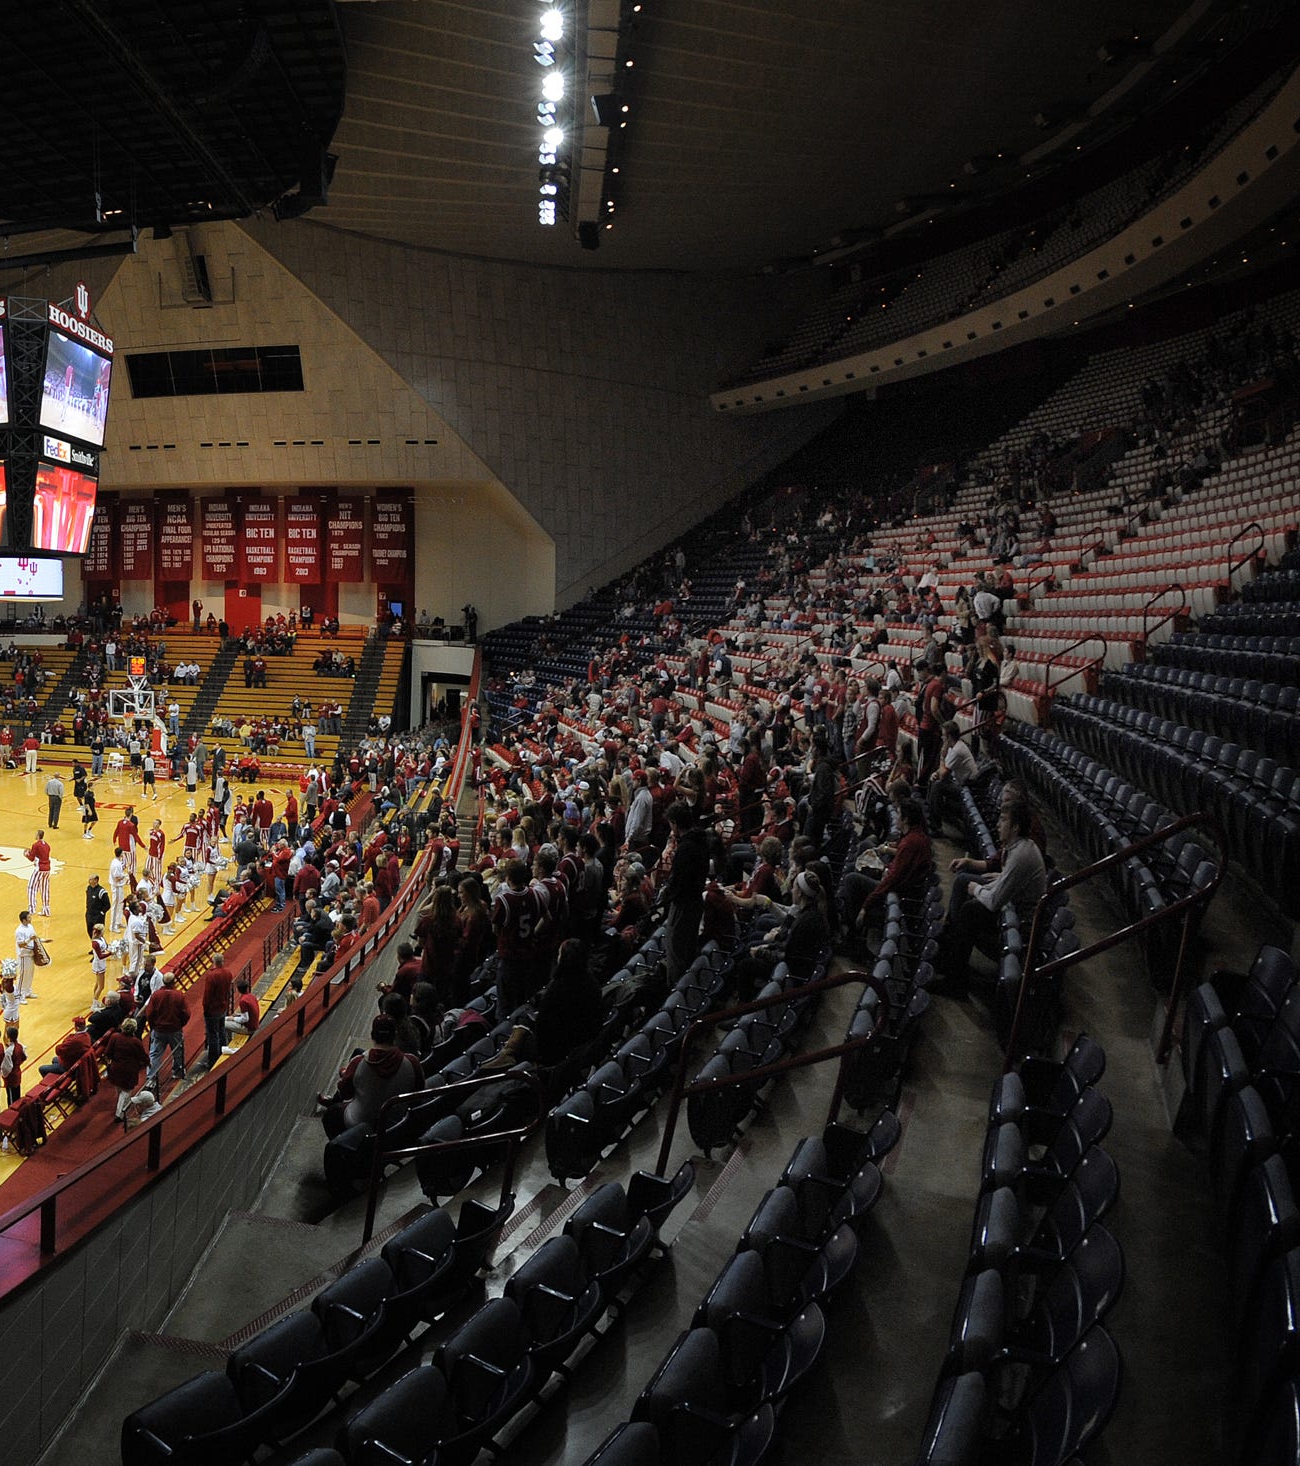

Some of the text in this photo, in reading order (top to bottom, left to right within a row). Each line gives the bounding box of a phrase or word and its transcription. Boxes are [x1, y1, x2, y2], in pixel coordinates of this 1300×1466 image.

[49, 305, 113, 354] HOOSIERS
[45, 439, 68, 460] FedEx
[167, 515, 187, 523] NCAA
[340, 511, 351, 520] NIT
[120, 524, 151, 532] CHAMPIONS
[328, 521, 362, 529] CHAMPIONS
[374, 524, 406, 532] CHAMPIONS
[246, 528, 274, 538] BIG TEN
[288, 528, 316, 538] BIG TEN
[520, 915, 531, 938] 5
